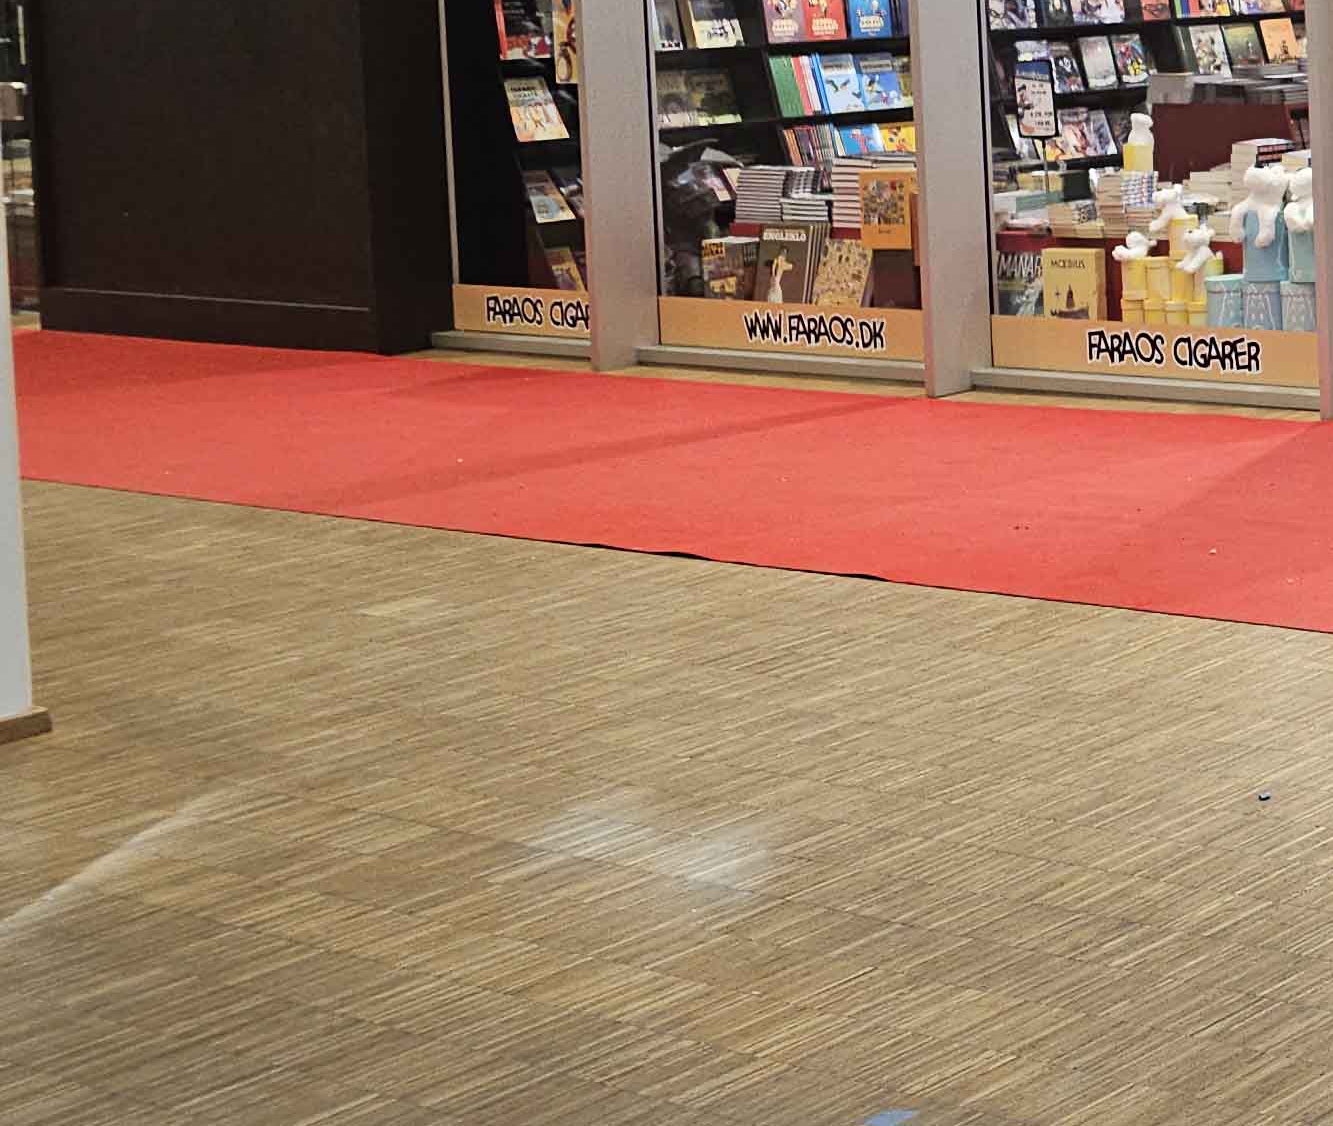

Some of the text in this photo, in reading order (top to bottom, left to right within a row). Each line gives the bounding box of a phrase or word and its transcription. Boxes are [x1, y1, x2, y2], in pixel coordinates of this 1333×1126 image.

[486, 296, 544, 326] FARAOS
[744, 312, 885, 349] WWW.FARAOS.DK
[1088, 330, 1261, 372] FARAOS CIGARER
